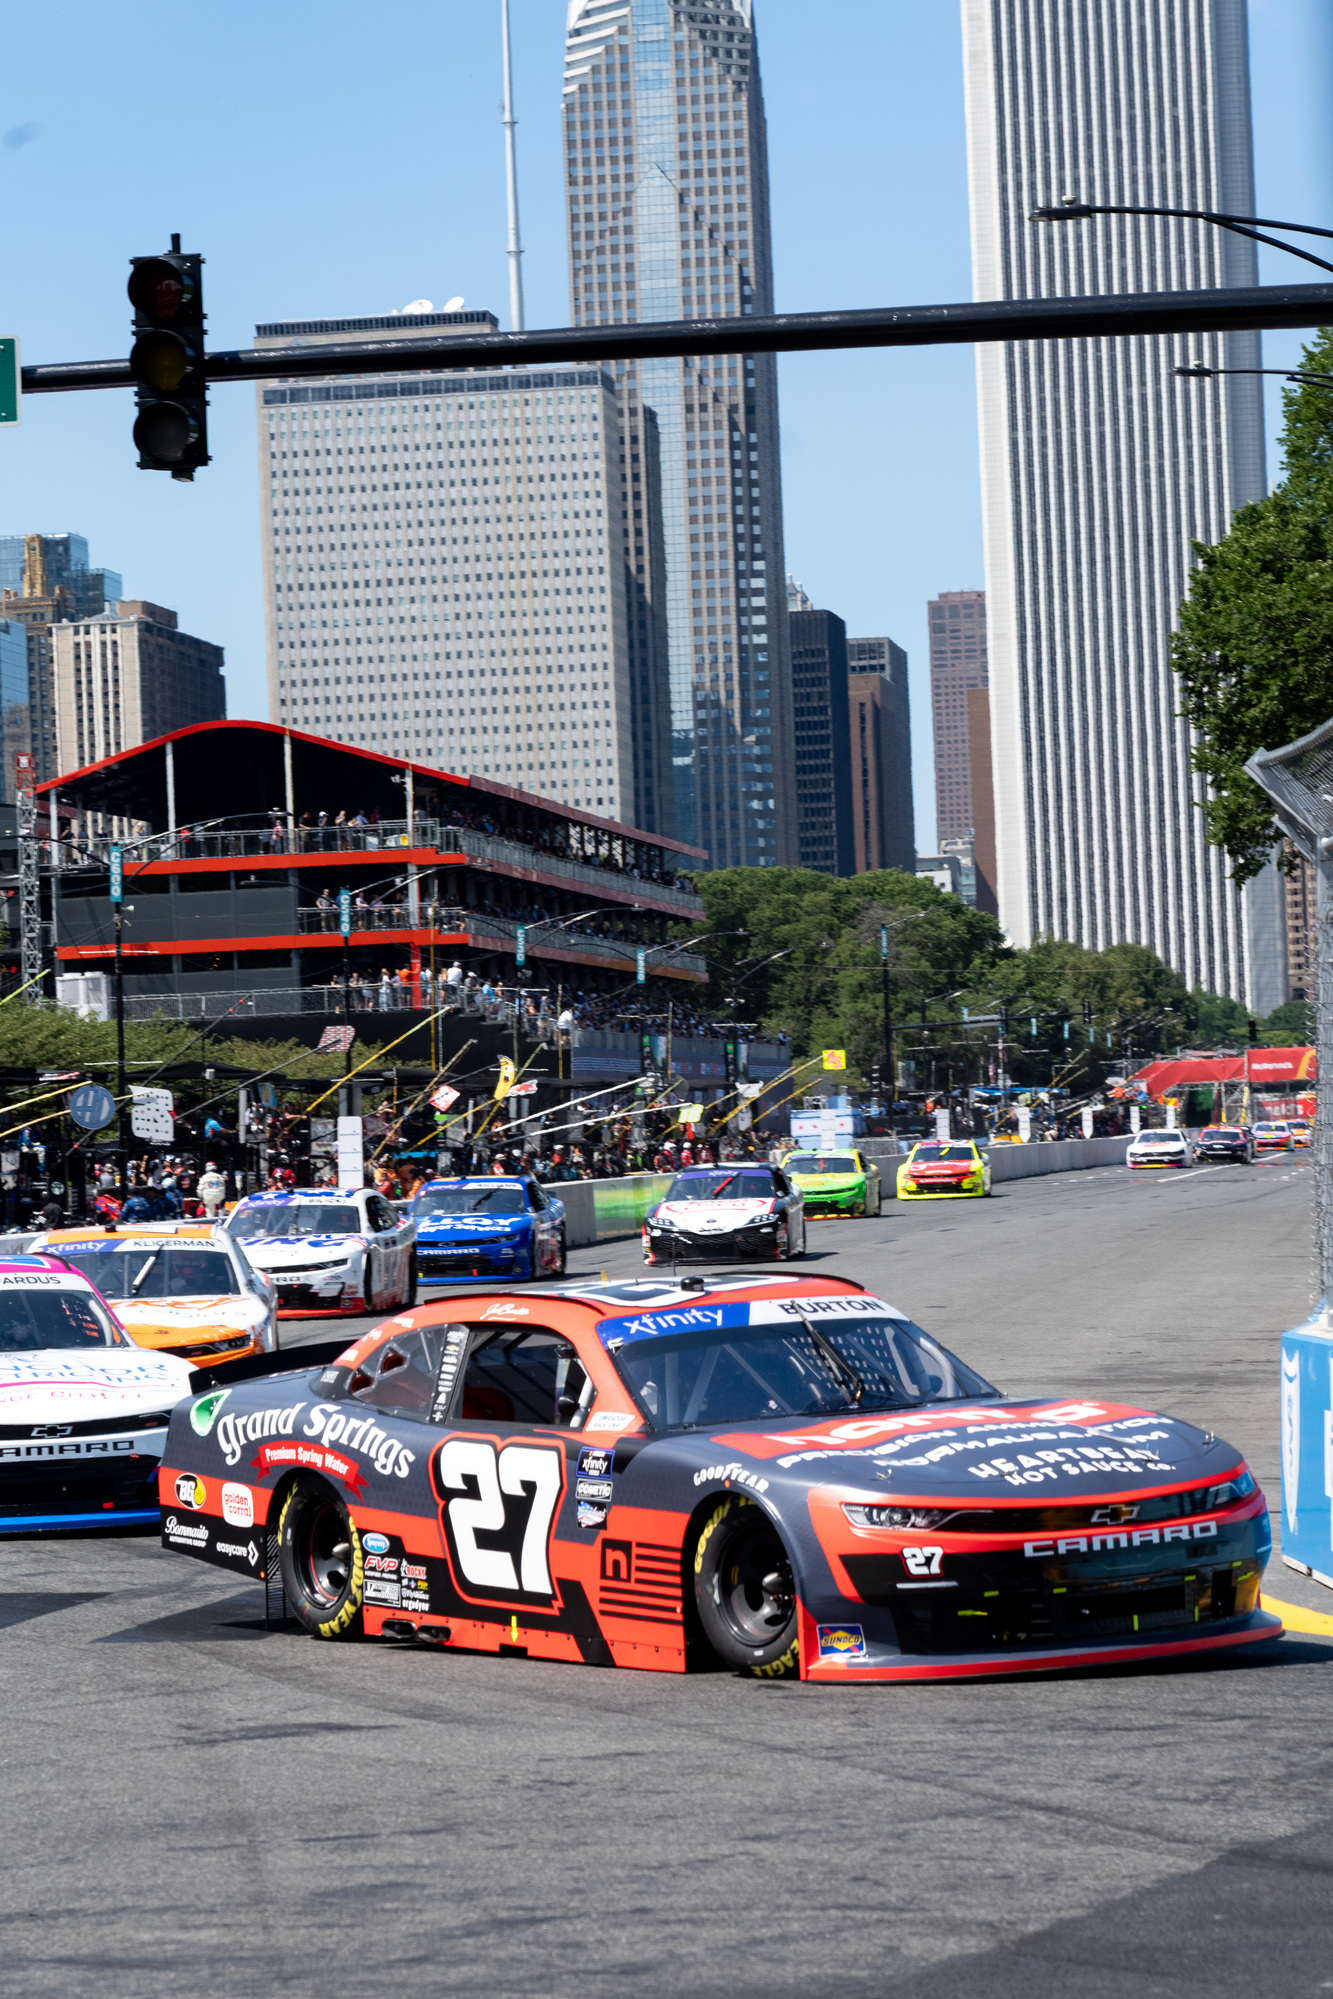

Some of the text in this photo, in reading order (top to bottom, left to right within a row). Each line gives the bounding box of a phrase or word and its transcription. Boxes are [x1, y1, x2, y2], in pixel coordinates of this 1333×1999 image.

[111, 852, 121, 896] C600
[340, 895, 350, 932] C540
[47, 1241, 107, 1255] xfinity
[133, 1240, 215, 1248] KLIGERMAN
[0, 1276, 61, 1285] ARDUS
[777, 1300, 887, 1315] BURTON
[622, 1309, 723, 1335] xfinity
[302, 1403, 417, 1479] Springs
[775, 1429, 957, 1469] PRECISION
[265, 1446, 350, 1476] Premium Spring Water
[582, 1456, 609, 1474] xfinity
[1004, 1467, 1059, 1486] HOT
[1061, 1460, 1143, 1475] SAUCE
[577, 1482, 611, 1497] COMETIC
[693, 1462, 770, 1494] GOODYEAR
[223, 1493, 249, 1506] golden
[228, 1505, 252, 1517] corral
[165, 1515, 210, 1541] Bommarito
[440, 1440, 561, 1595] 27
[216, 1541, 248, 1557] easycare
[1023, 1520, 1218, 1558] CAMARO
[364, 1556, 398, 1572] FVP
[406, 1566, 426, 1579] ROCKY
[902, 1546, 944, 1575] 27
[318, 1516, 365, 1638] GOODYEAR
[822, 1635, 861, 1647] SUNOCO
